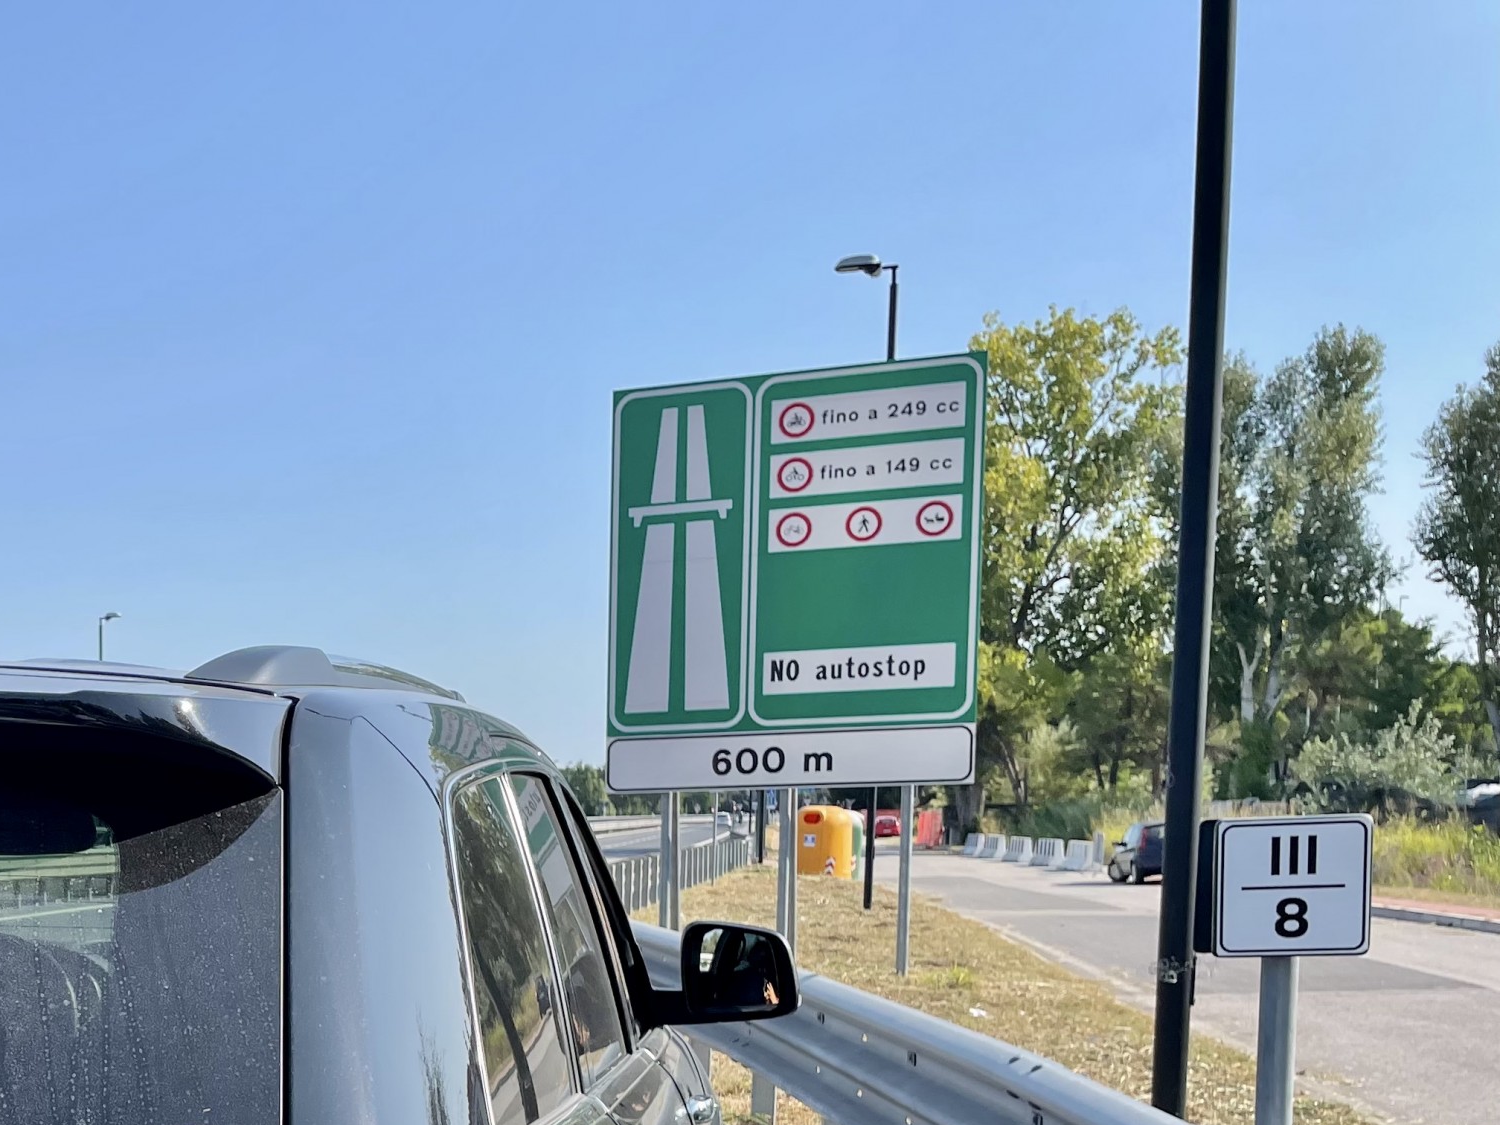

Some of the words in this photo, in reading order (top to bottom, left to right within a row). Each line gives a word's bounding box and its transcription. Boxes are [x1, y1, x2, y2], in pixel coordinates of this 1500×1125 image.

[821, 409, 859, 425] fino
[868, 408, 878, 420] a
[887, 400, 927, 418] 249
[936, 400, 960, 414] cc
[820, 464, 857, 480] fino
[866, 464, 876, 476] a
[886, 457, 920, 474] 149
[929, 457, 953, 470] cc
[770, 659, 800, 682] NO
[815, 654, 926, 681] autostop
[712, 746, 786, 776] 600
[803, 752, 833, 773] m
[1271, 835, 1317, 876] III
[1274, 897, 1309, 938] 8
